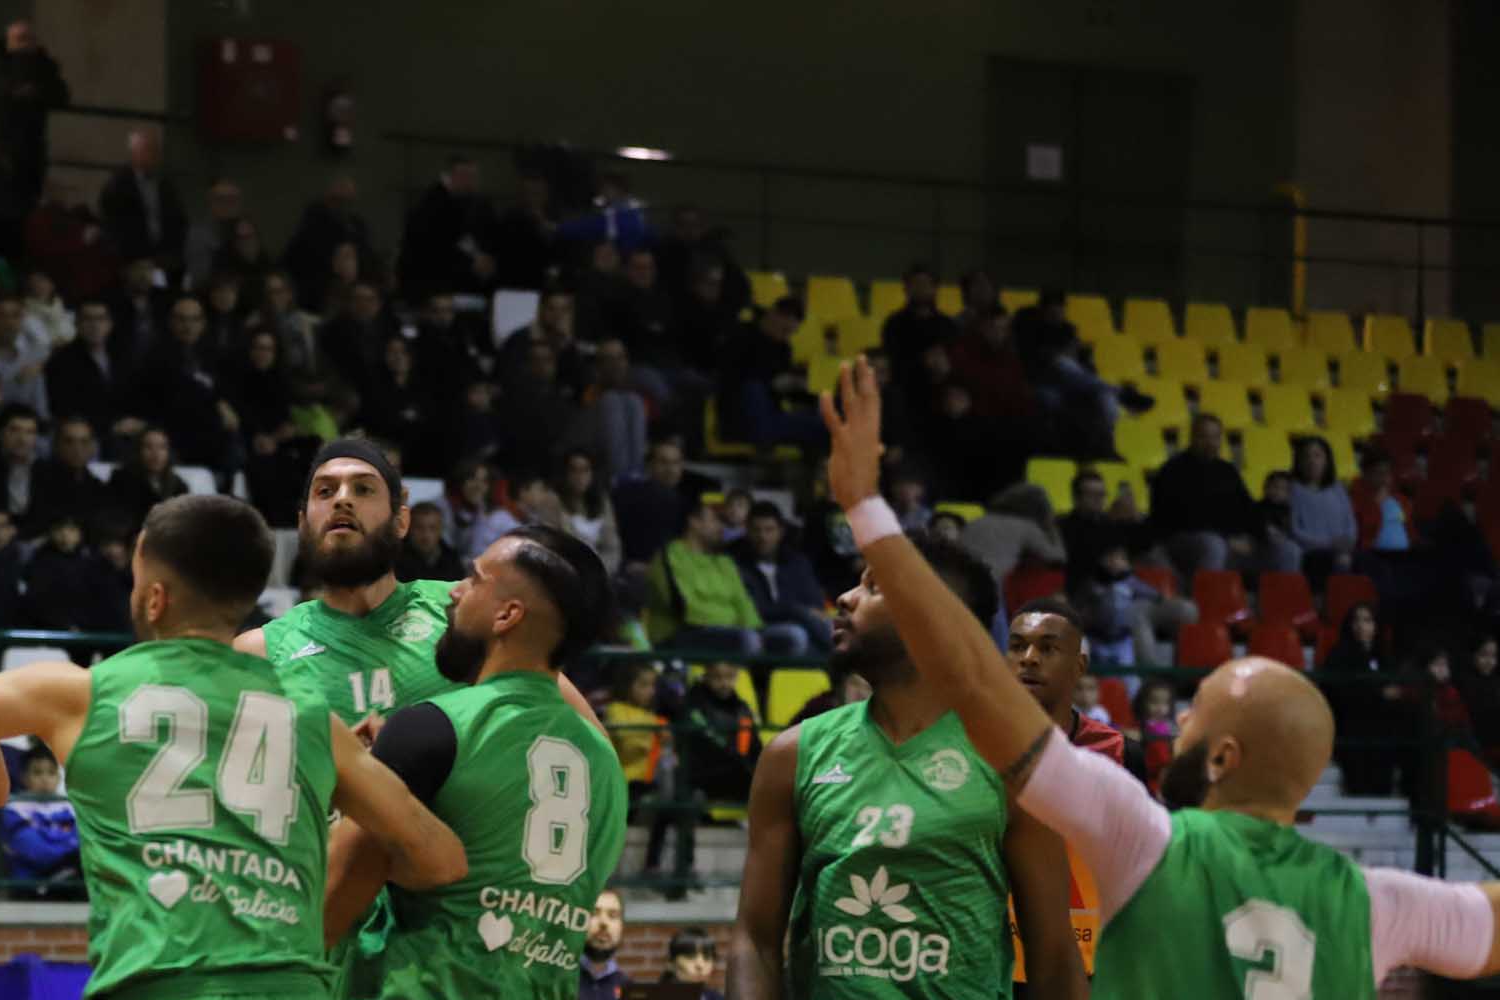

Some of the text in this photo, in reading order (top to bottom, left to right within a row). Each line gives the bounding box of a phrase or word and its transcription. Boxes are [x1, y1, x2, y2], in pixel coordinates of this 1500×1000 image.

[348, 667, 397, 714] 14
[119, 684, 300, 846] 24
[522, 735, 592, 886] 8
[851, 803, 916, 849] 23
[142, 839, 302, 892] CHANTADA
